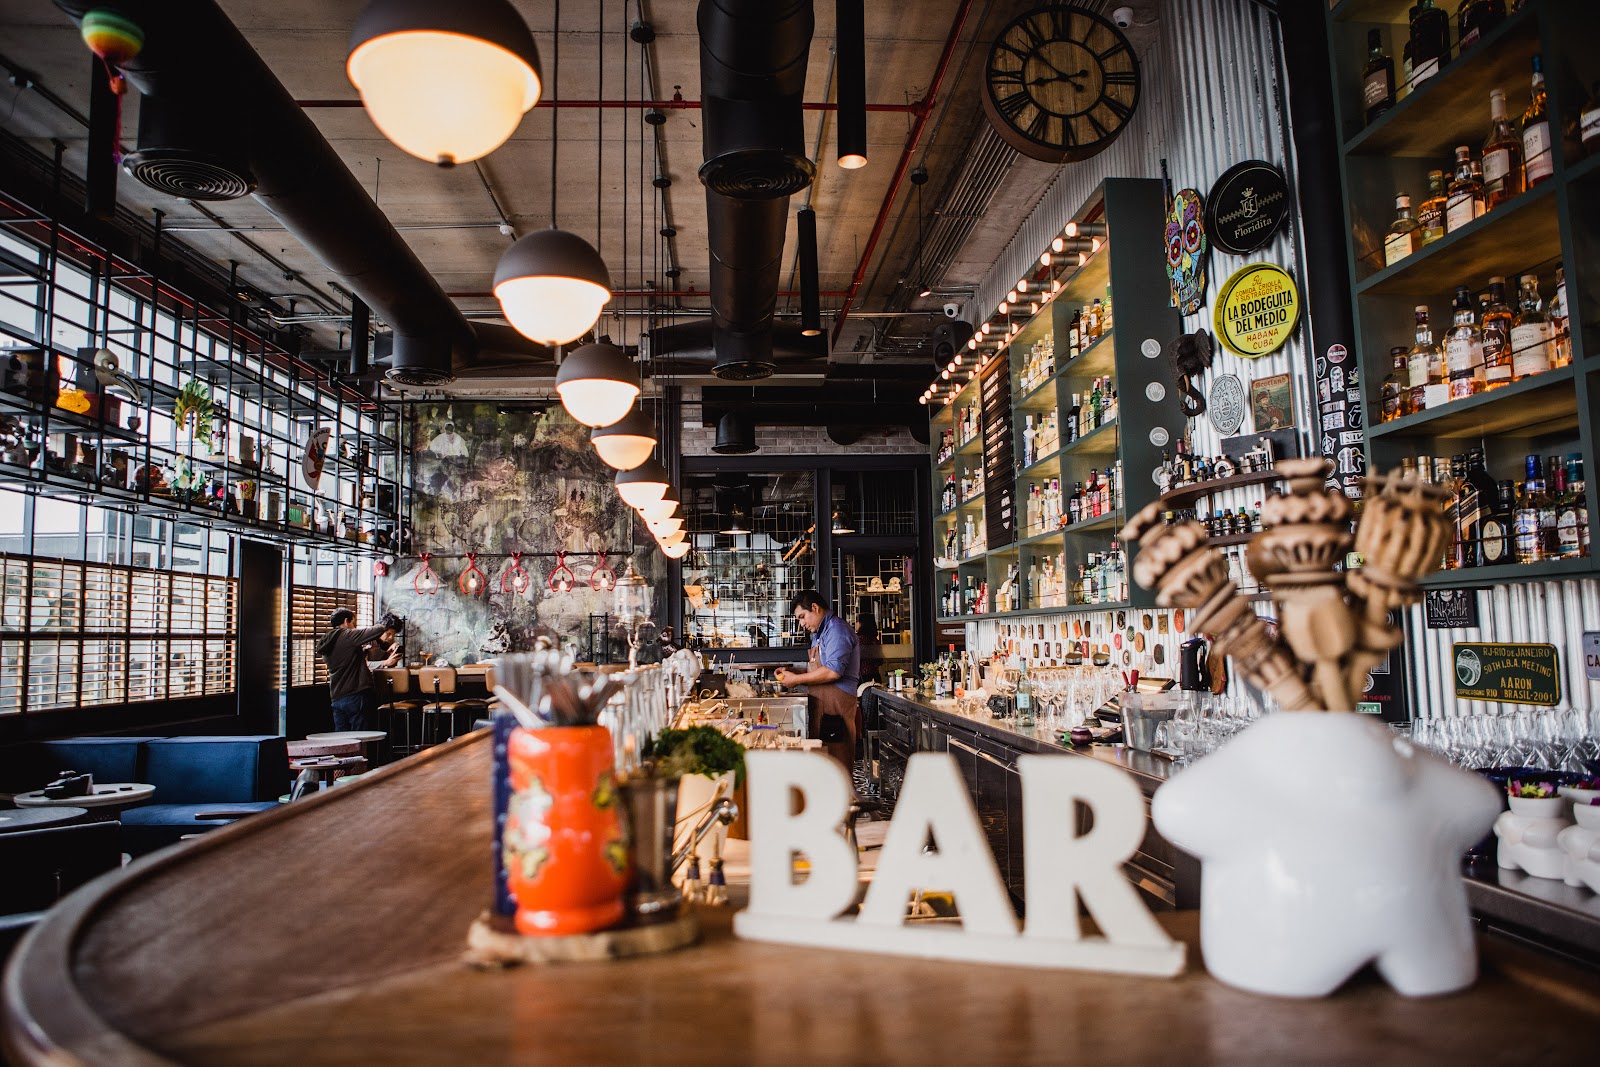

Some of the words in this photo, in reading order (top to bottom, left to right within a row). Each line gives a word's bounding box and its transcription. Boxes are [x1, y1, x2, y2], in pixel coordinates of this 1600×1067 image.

[1234, 218, 1272, 239] Floridita
[1236, 287, 1256, 298] COMIDA
[1258, 279, 1281, 291] CRIOLLA
[1241, 294, 1251, 302] SUS
[1251, 288, 1273, 298] TRAGOS
[1275, 285, 1282, 293] EN
[1228, 305, 1238, 320] LA
[1240, 290, 1293, 317] BODEGUITA
[1236, 318, 1252, 334] DEL
[1255, 309, 1287, 328] MEDIO
[1246, 328, 1279, 342] HABANA
[1253, 338, 1274, 350] CUBA
[1515, 648, 1550, 658] JANEIRO
[1484, 661, 1500, 675] 50TH
[1521, 659, 1552, 678] MEETING
[1500, 676, 1532, 690] AARON
[1485, 688, 1498, 698] RIO
[744, 750, 1176, 947] BAR
